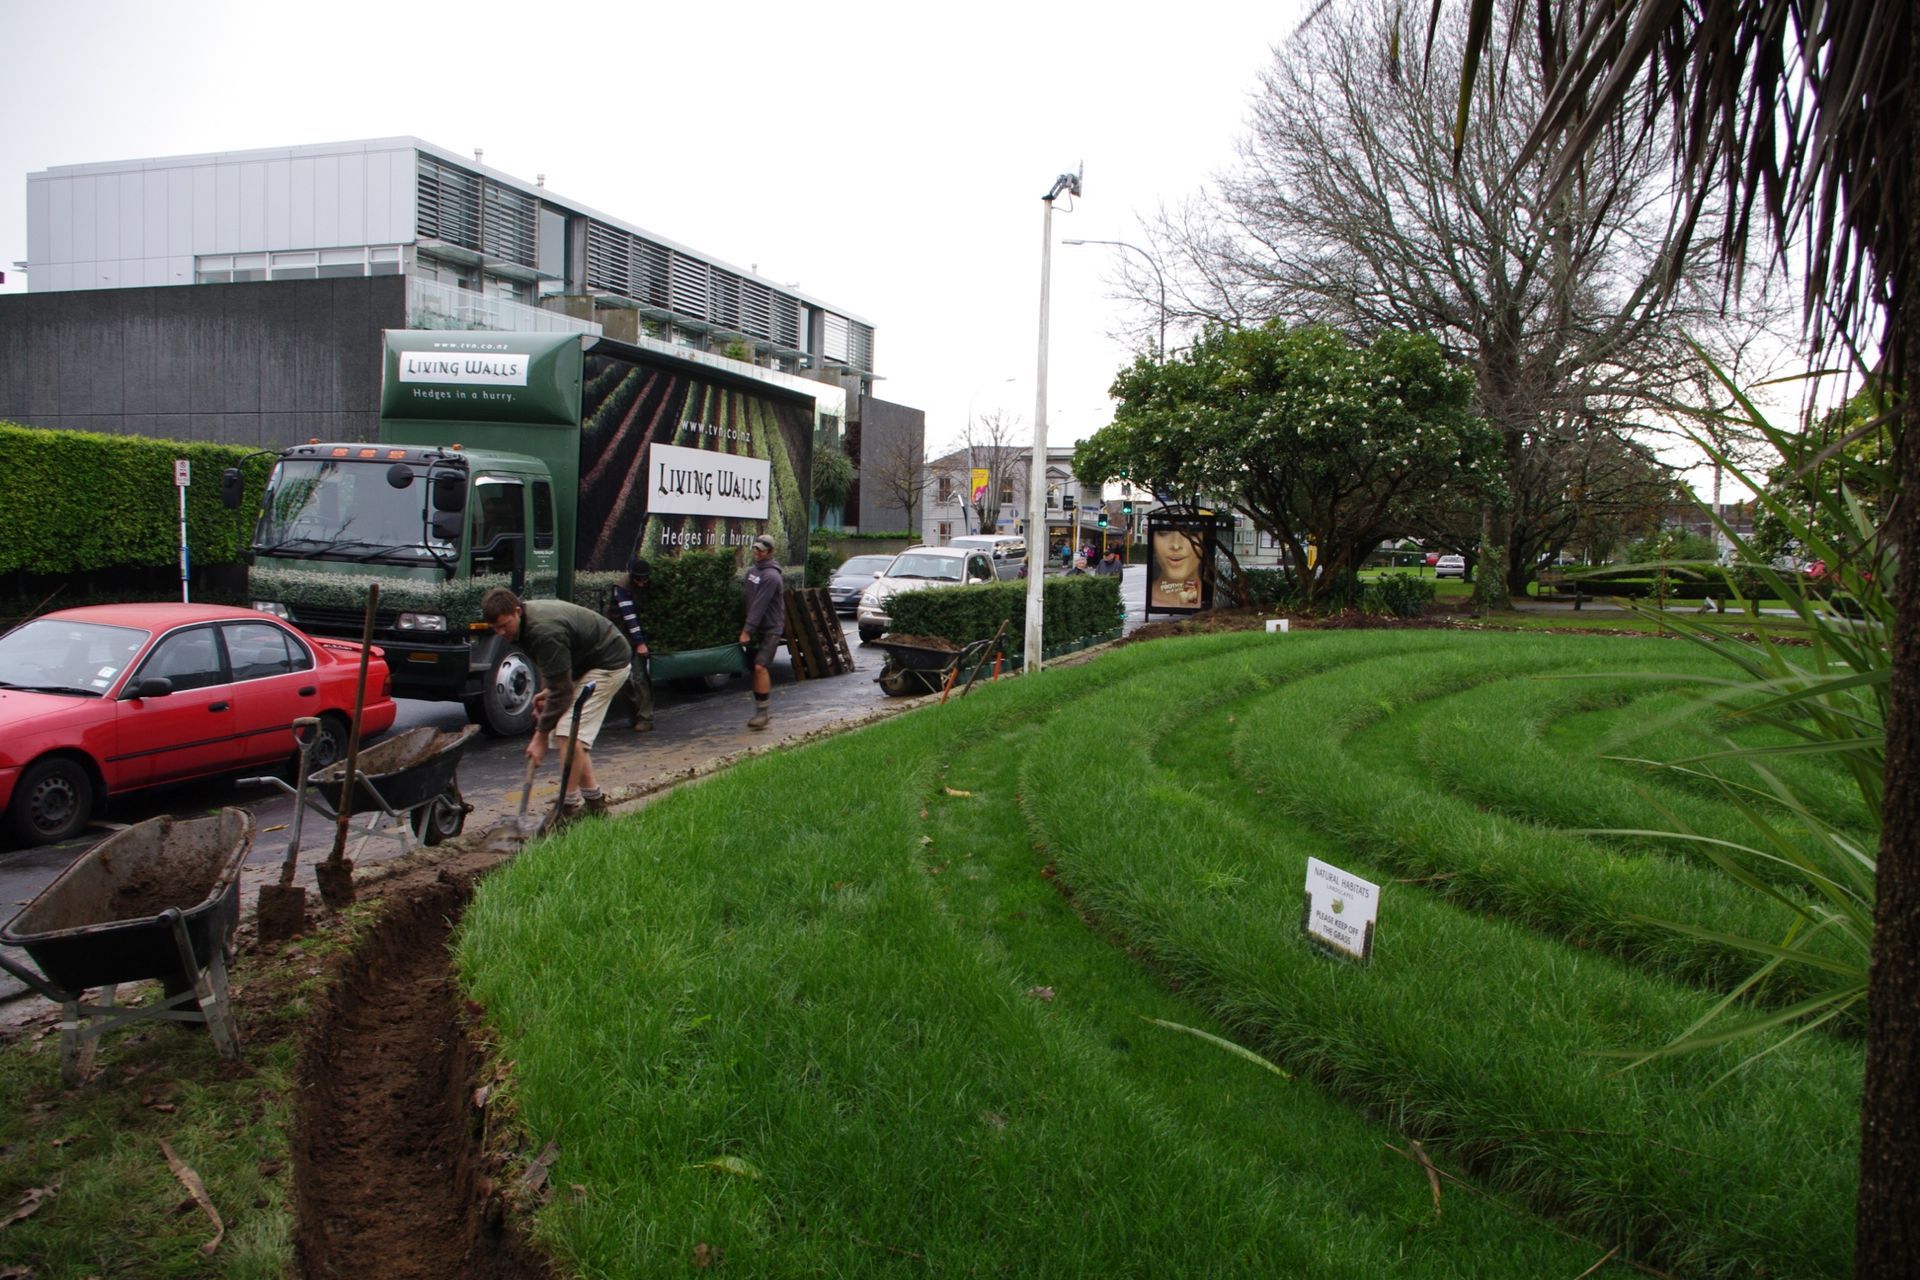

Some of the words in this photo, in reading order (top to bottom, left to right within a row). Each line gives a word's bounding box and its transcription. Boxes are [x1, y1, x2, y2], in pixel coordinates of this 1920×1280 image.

[433, 342, 509, 351] www.tvn.co.nz
[408, 359, 460, 377] LIVING
[465, 360, 517, 377] WALLS
[413, 388, 452, 400] Hedges
[456, 389, 466, 399] in
[482, 390, 516, 402] hurry.
[681, 420, 751, 442] www.tvn.co.nz
[658, 462, 713, 502] LIVING
[717, 469, 762, 502] WALLS
[661, 526, 702, 550] Hedges
[706, 529, 715, 545] in
[720, 533, 726, 545] a
[1314, 867, 1339, 885] NATURAL
[1341, 878, 1369, 898] HABITATS
[1316, 910, 1334, 925] PLEASE
[1334, 919, 1348, 931] KEEP
[1348, 925, 1359, 937] OFF
[1323, 924, 1333, 937] THE
[1333, 930, 1351, 945] GRASS
